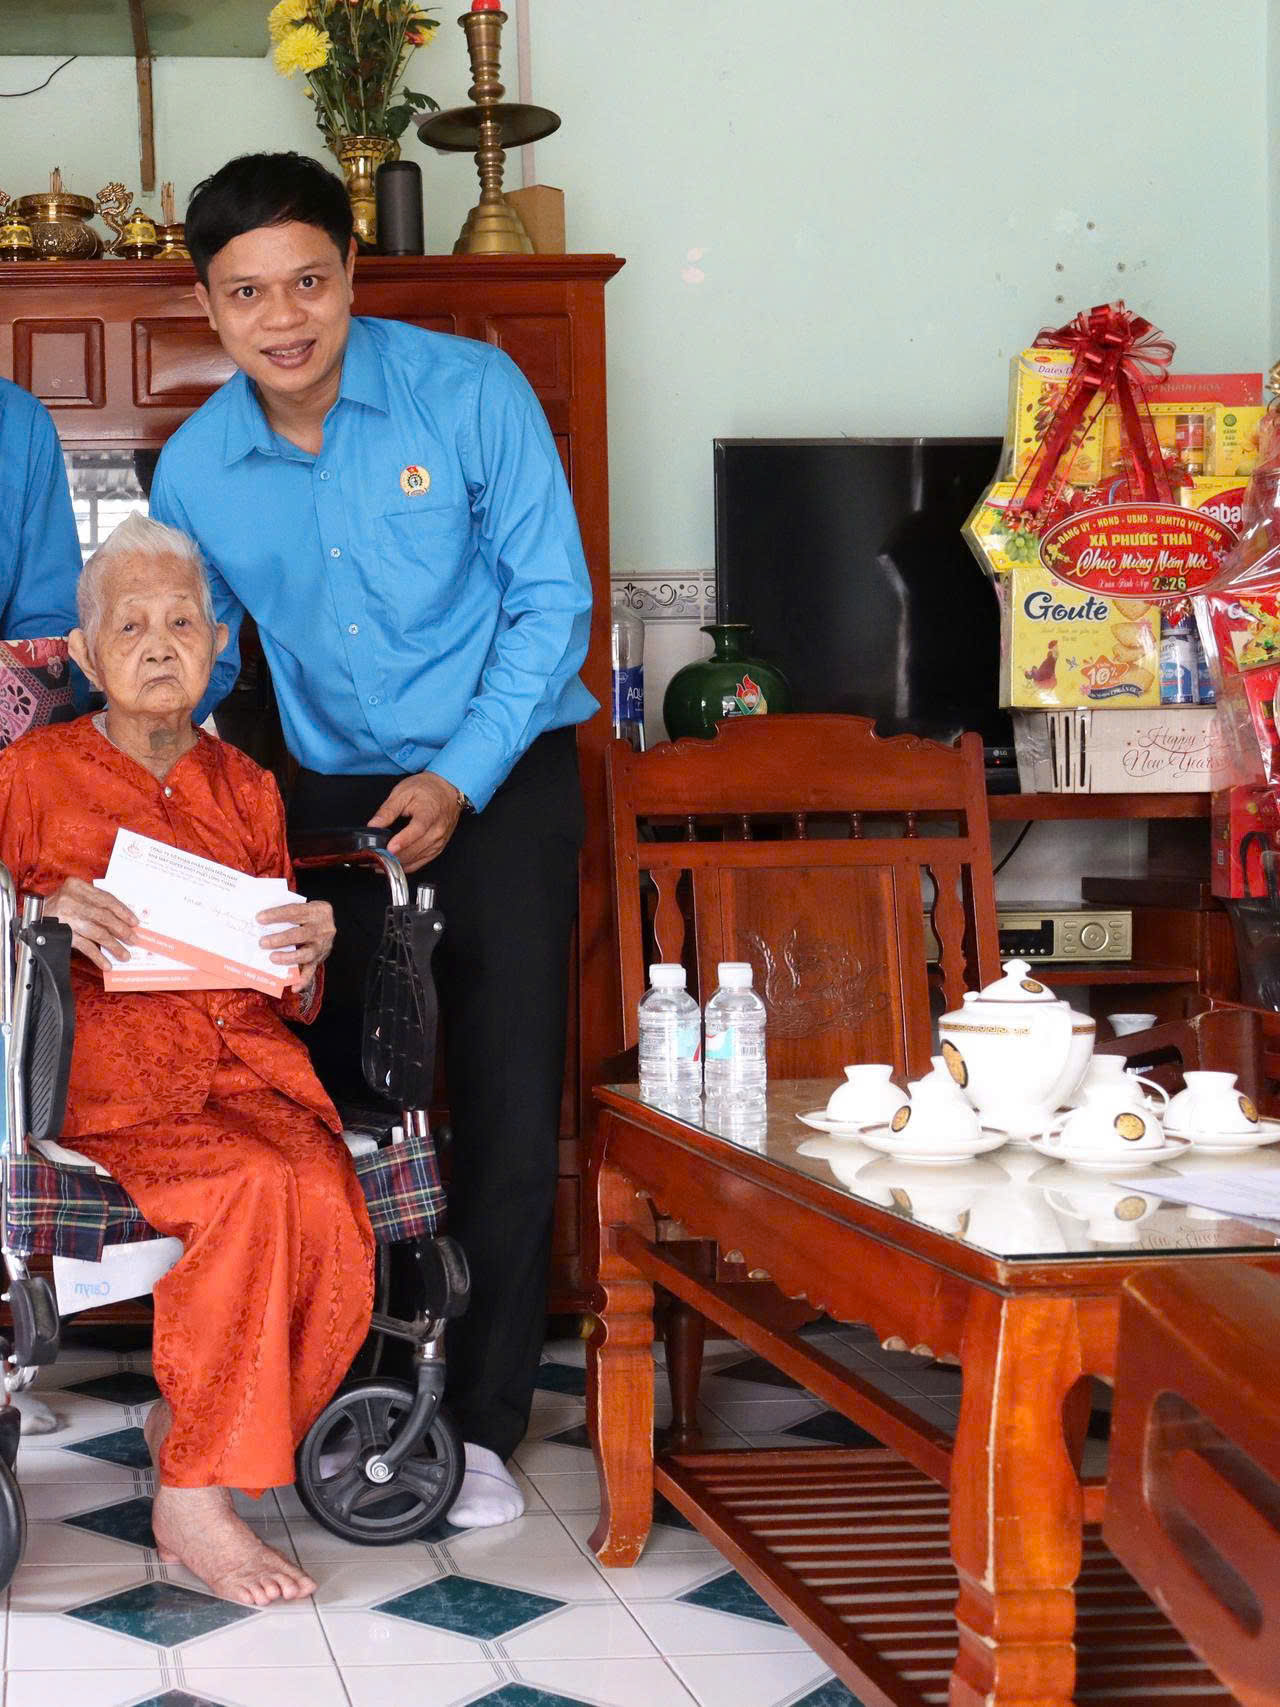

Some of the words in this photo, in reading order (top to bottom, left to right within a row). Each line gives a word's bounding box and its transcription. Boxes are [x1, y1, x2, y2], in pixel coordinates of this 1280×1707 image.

[1089, 532, 1107, 547] XÃ
[1111, 532, 1158, 547] PHƯỚC
[1163, 531, 1193, 546] THÁI
[1065, 548, 1117, 577] Chúc
[1119, 552, 1155, 576] Mừng
[1156, 552, 1186, 575] Năm
[1023, 591, 1109, 621] Gouté
[1138, 726, 1202, 753] Happy
[1122, 749, 1170, 777] New
